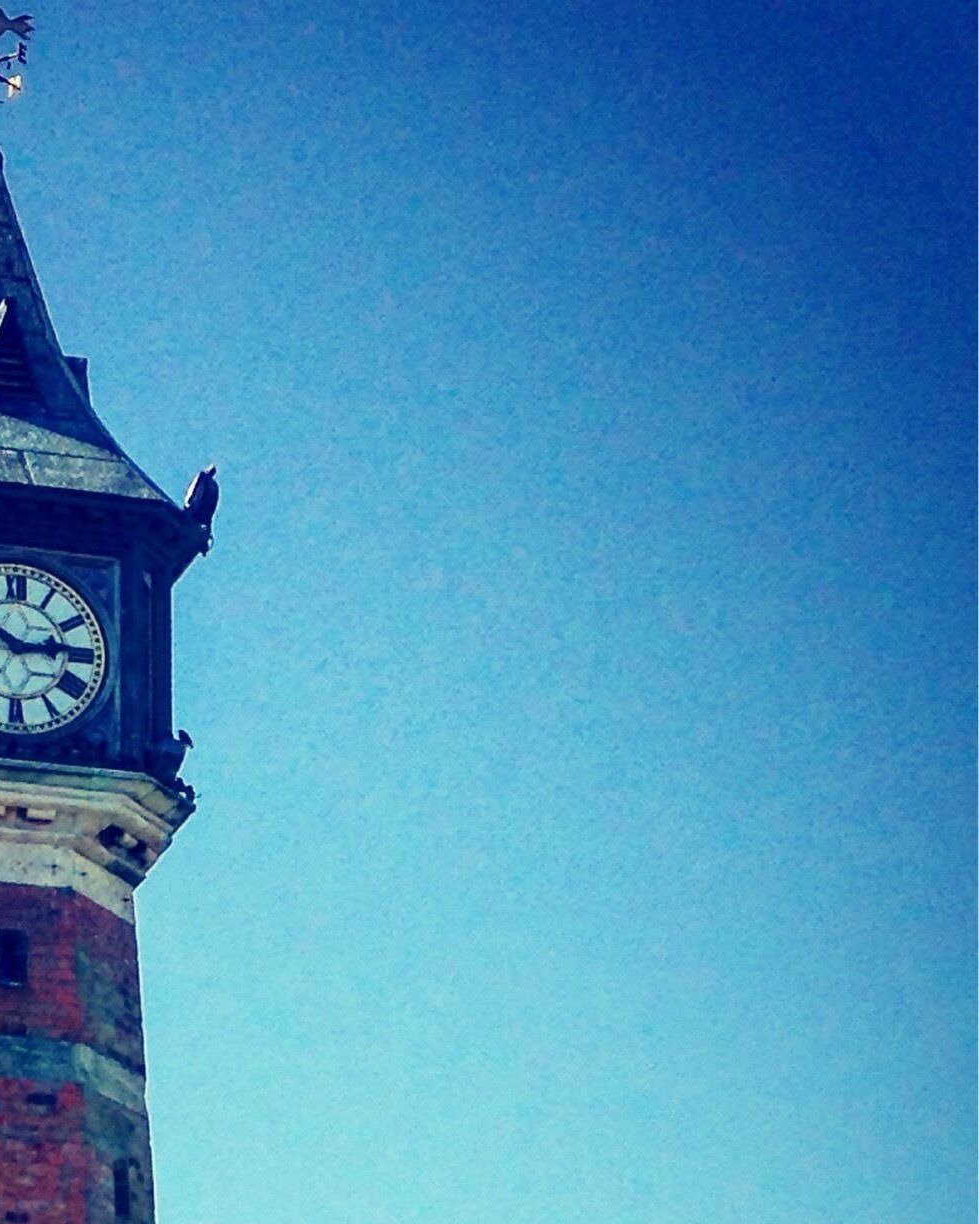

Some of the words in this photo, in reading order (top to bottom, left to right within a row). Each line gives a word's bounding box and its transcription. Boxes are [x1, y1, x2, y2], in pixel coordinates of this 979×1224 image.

[5, 574, 28, 601] XII
[57, 613, 86, 633] II
[8, 697, 25, 723] VI
[40, 692, 61, 718] V
